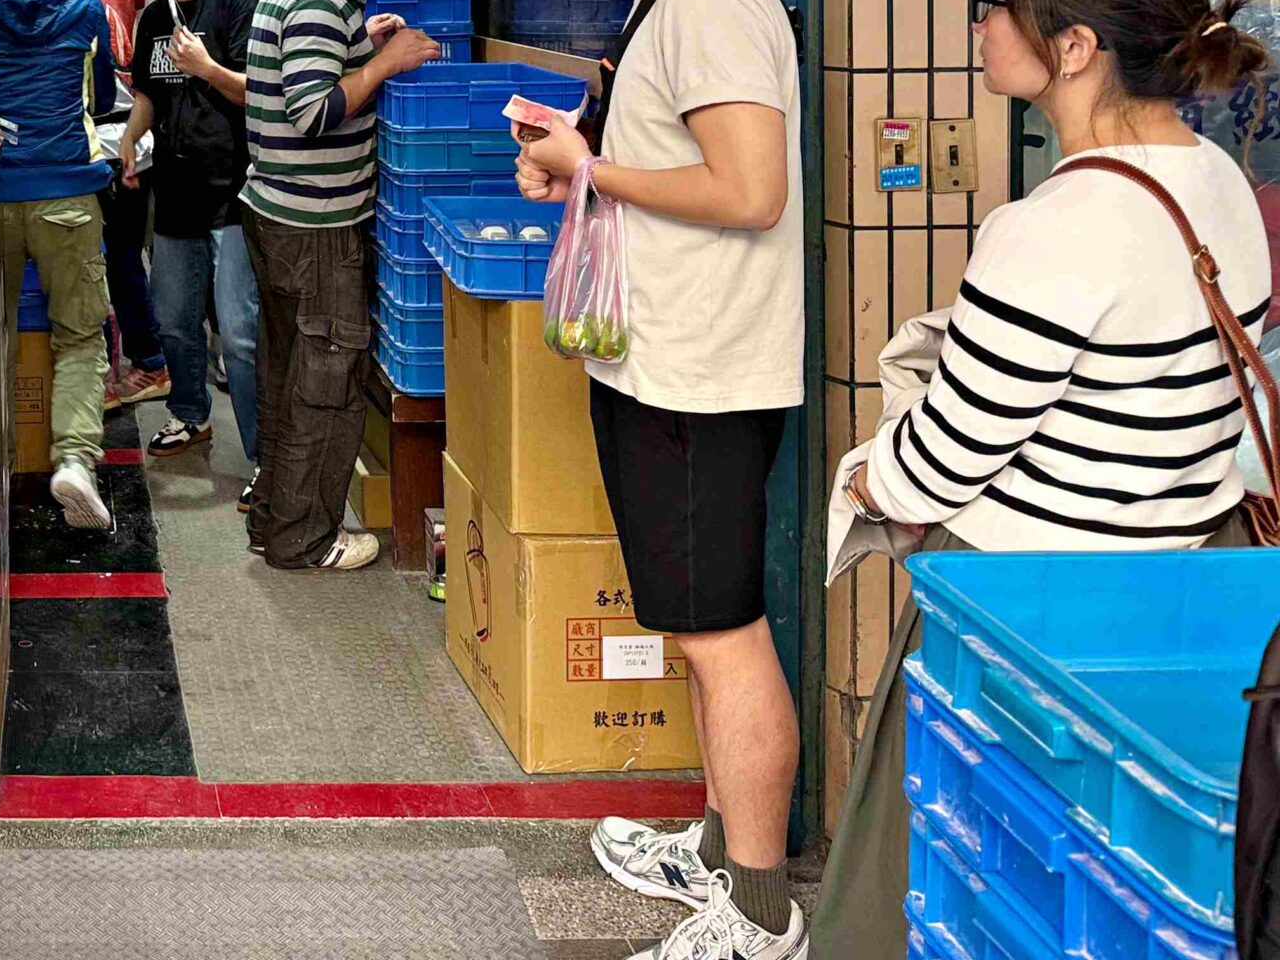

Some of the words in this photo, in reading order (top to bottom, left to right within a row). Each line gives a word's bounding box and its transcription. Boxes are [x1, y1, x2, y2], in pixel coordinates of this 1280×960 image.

[595, 589, 634, 607] 各式
[573, 643, 597, 657] 尺寸
[573, 663, 597, 677] 數量
[665, 662, 677, 675] 入
[593, 709, 667, 728] 歡迎訂購
